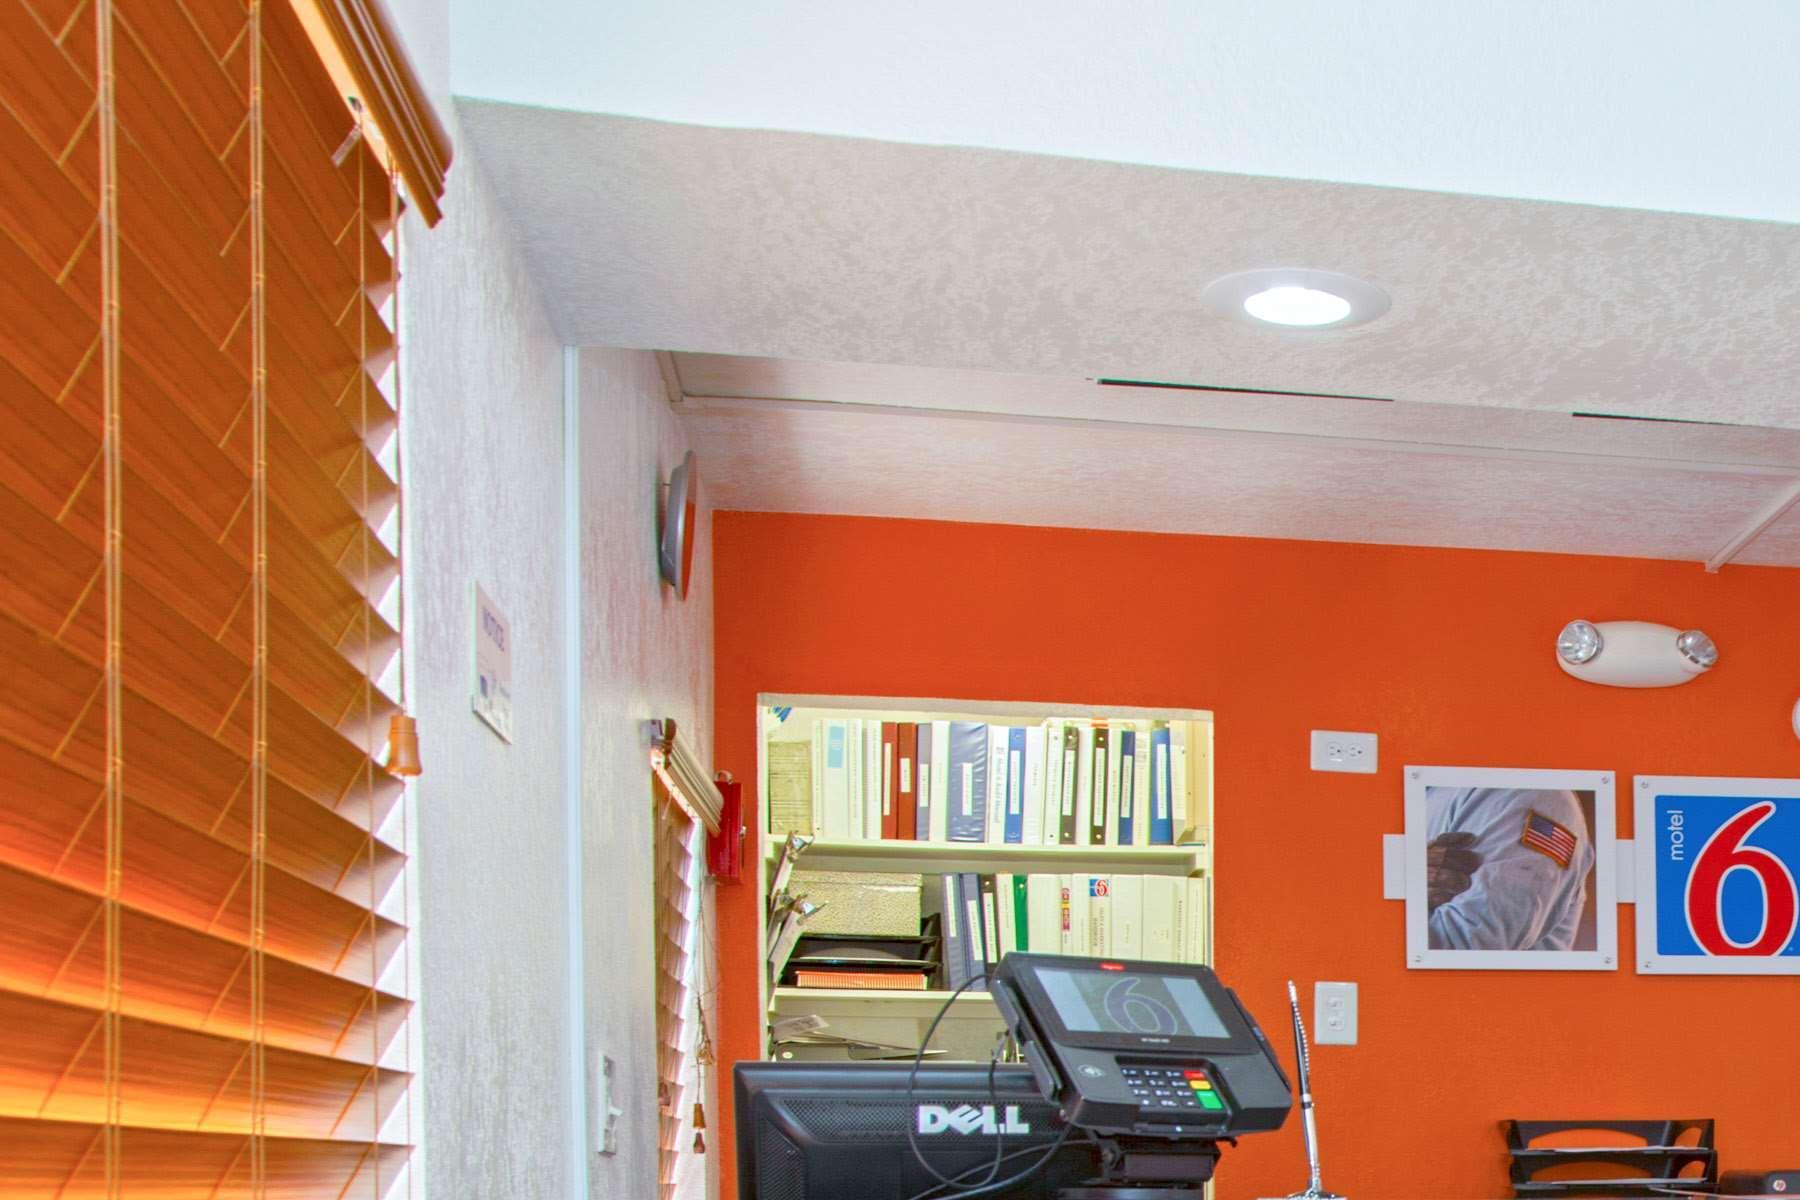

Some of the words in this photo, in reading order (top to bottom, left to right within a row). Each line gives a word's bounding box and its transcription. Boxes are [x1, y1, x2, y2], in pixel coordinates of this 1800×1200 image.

[1667, 810, 1684, 861] motel
[1684, 801, 1799, 957] 6
[917, 1104, 1030, 1135] DELL
